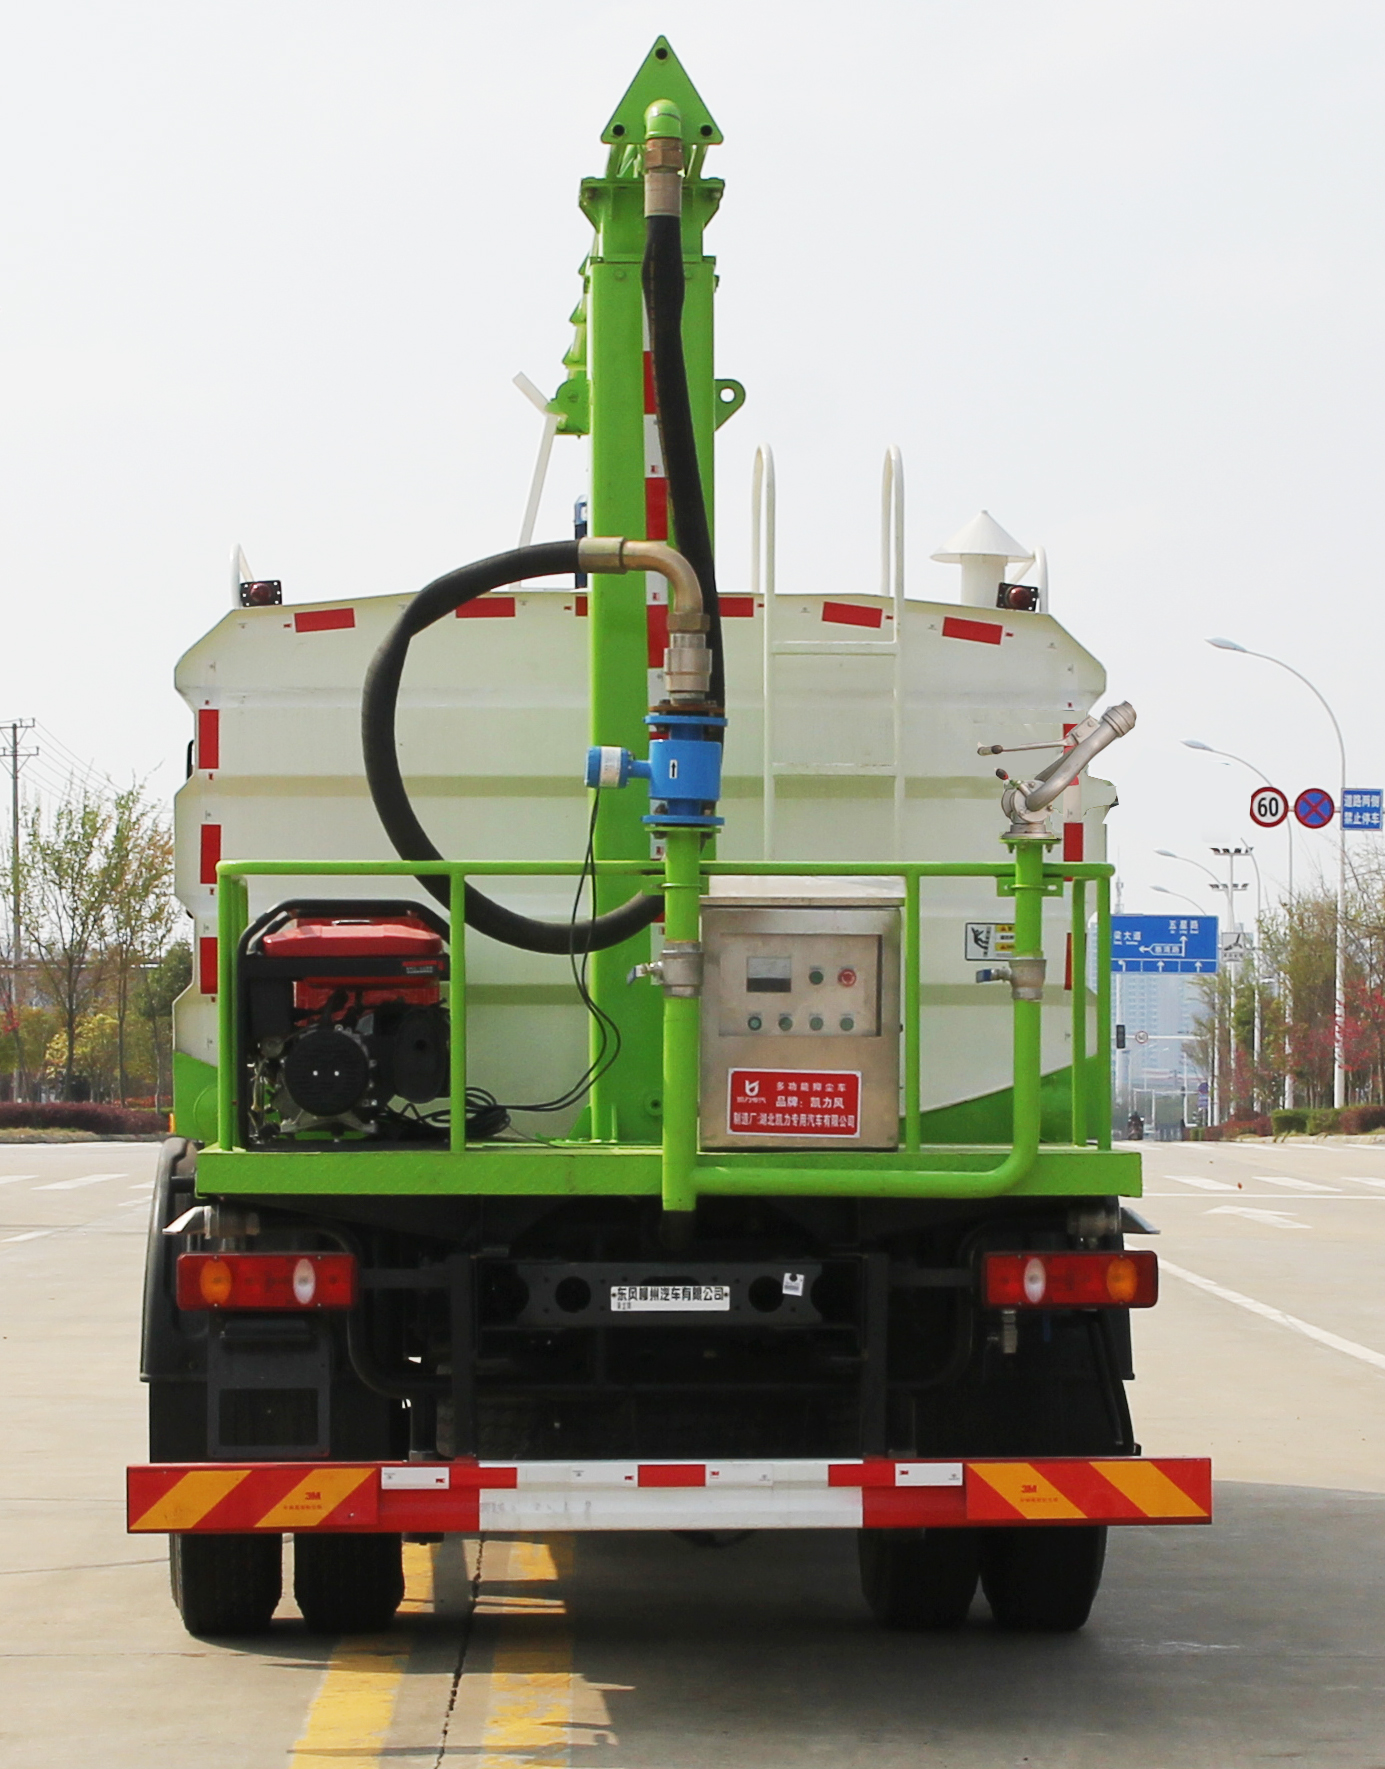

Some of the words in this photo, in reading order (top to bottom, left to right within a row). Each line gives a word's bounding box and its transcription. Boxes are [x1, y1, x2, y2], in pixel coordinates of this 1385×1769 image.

[1257, 797, 1279, 817] 60
[1021, 1484, 1037, 1493] 3M
[304, 1491, 321, 1500] 3M
